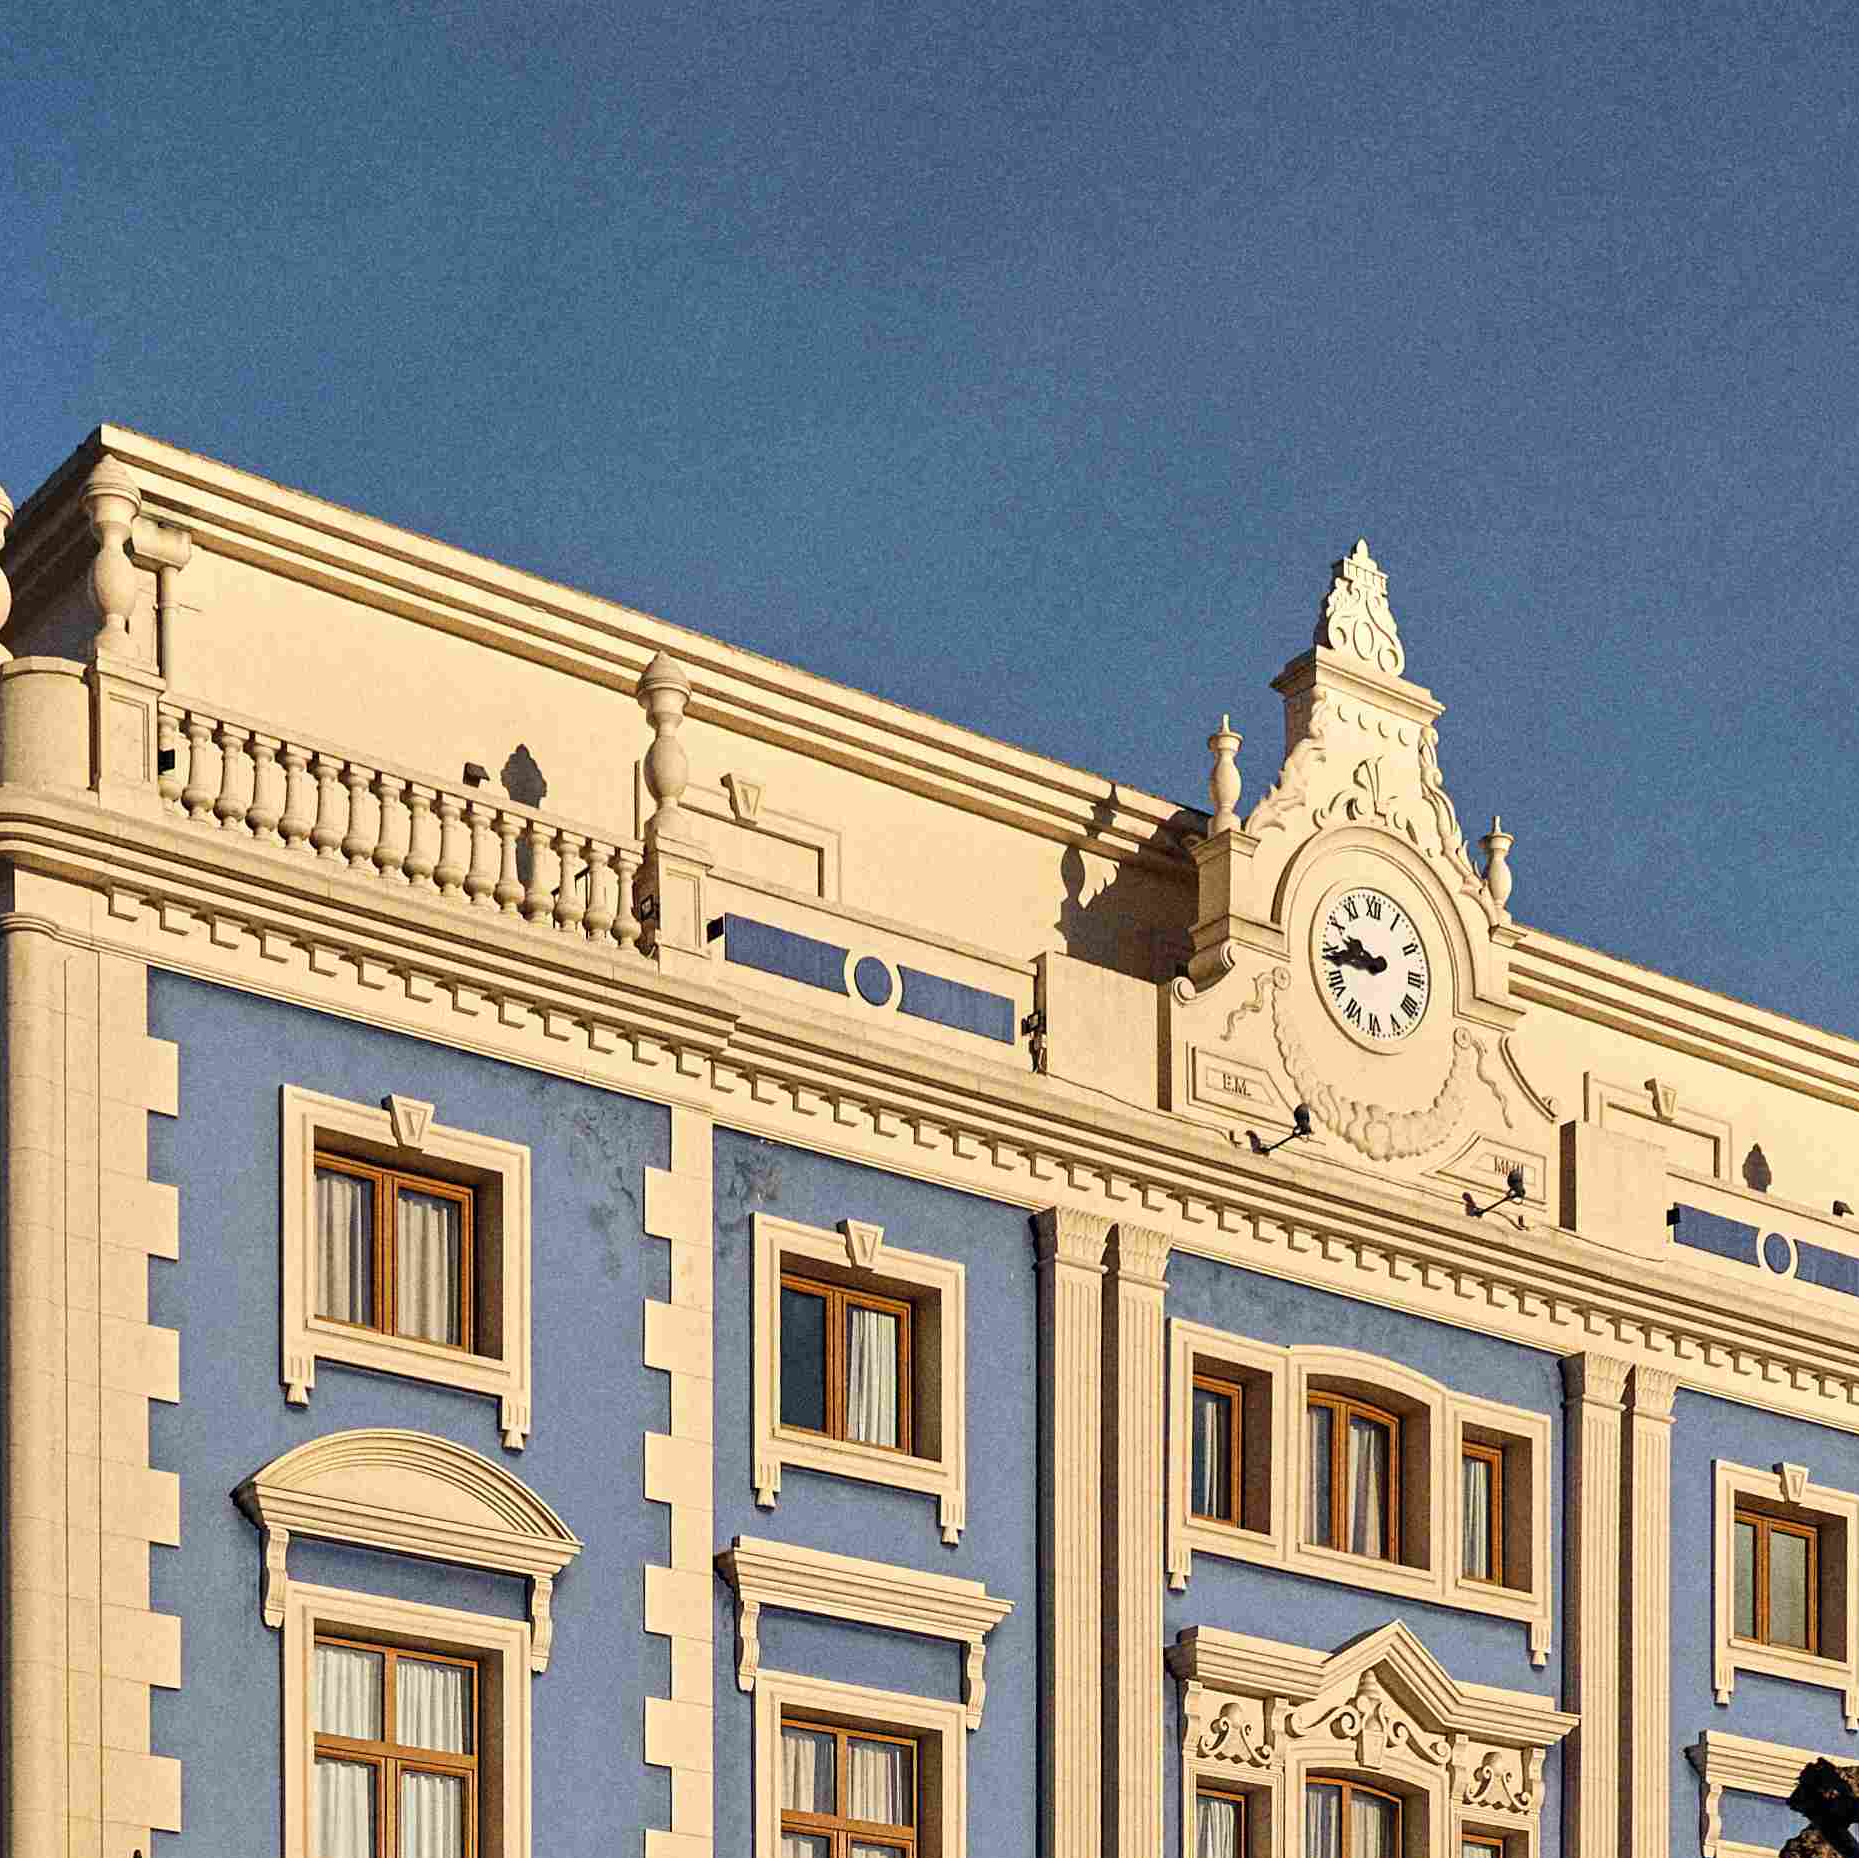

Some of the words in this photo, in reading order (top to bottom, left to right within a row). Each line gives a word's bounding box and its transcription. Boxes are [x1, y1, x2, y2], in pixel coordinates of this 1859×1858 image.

[1344, 900, 1359, 922] XI
[1366, 897, 1382, 921] XII
[1390, 913, 1401, 932] I
[1402, 943, 1417, 957] II
[1328, 970, 1346, 1000] VIII
[1408, 971, 1422, 989] III
[1346, 997, 1362, 1028] VII
[1390, 1014, 1401, 1031] V
[1369, 1013, 1381, 1033] VI
